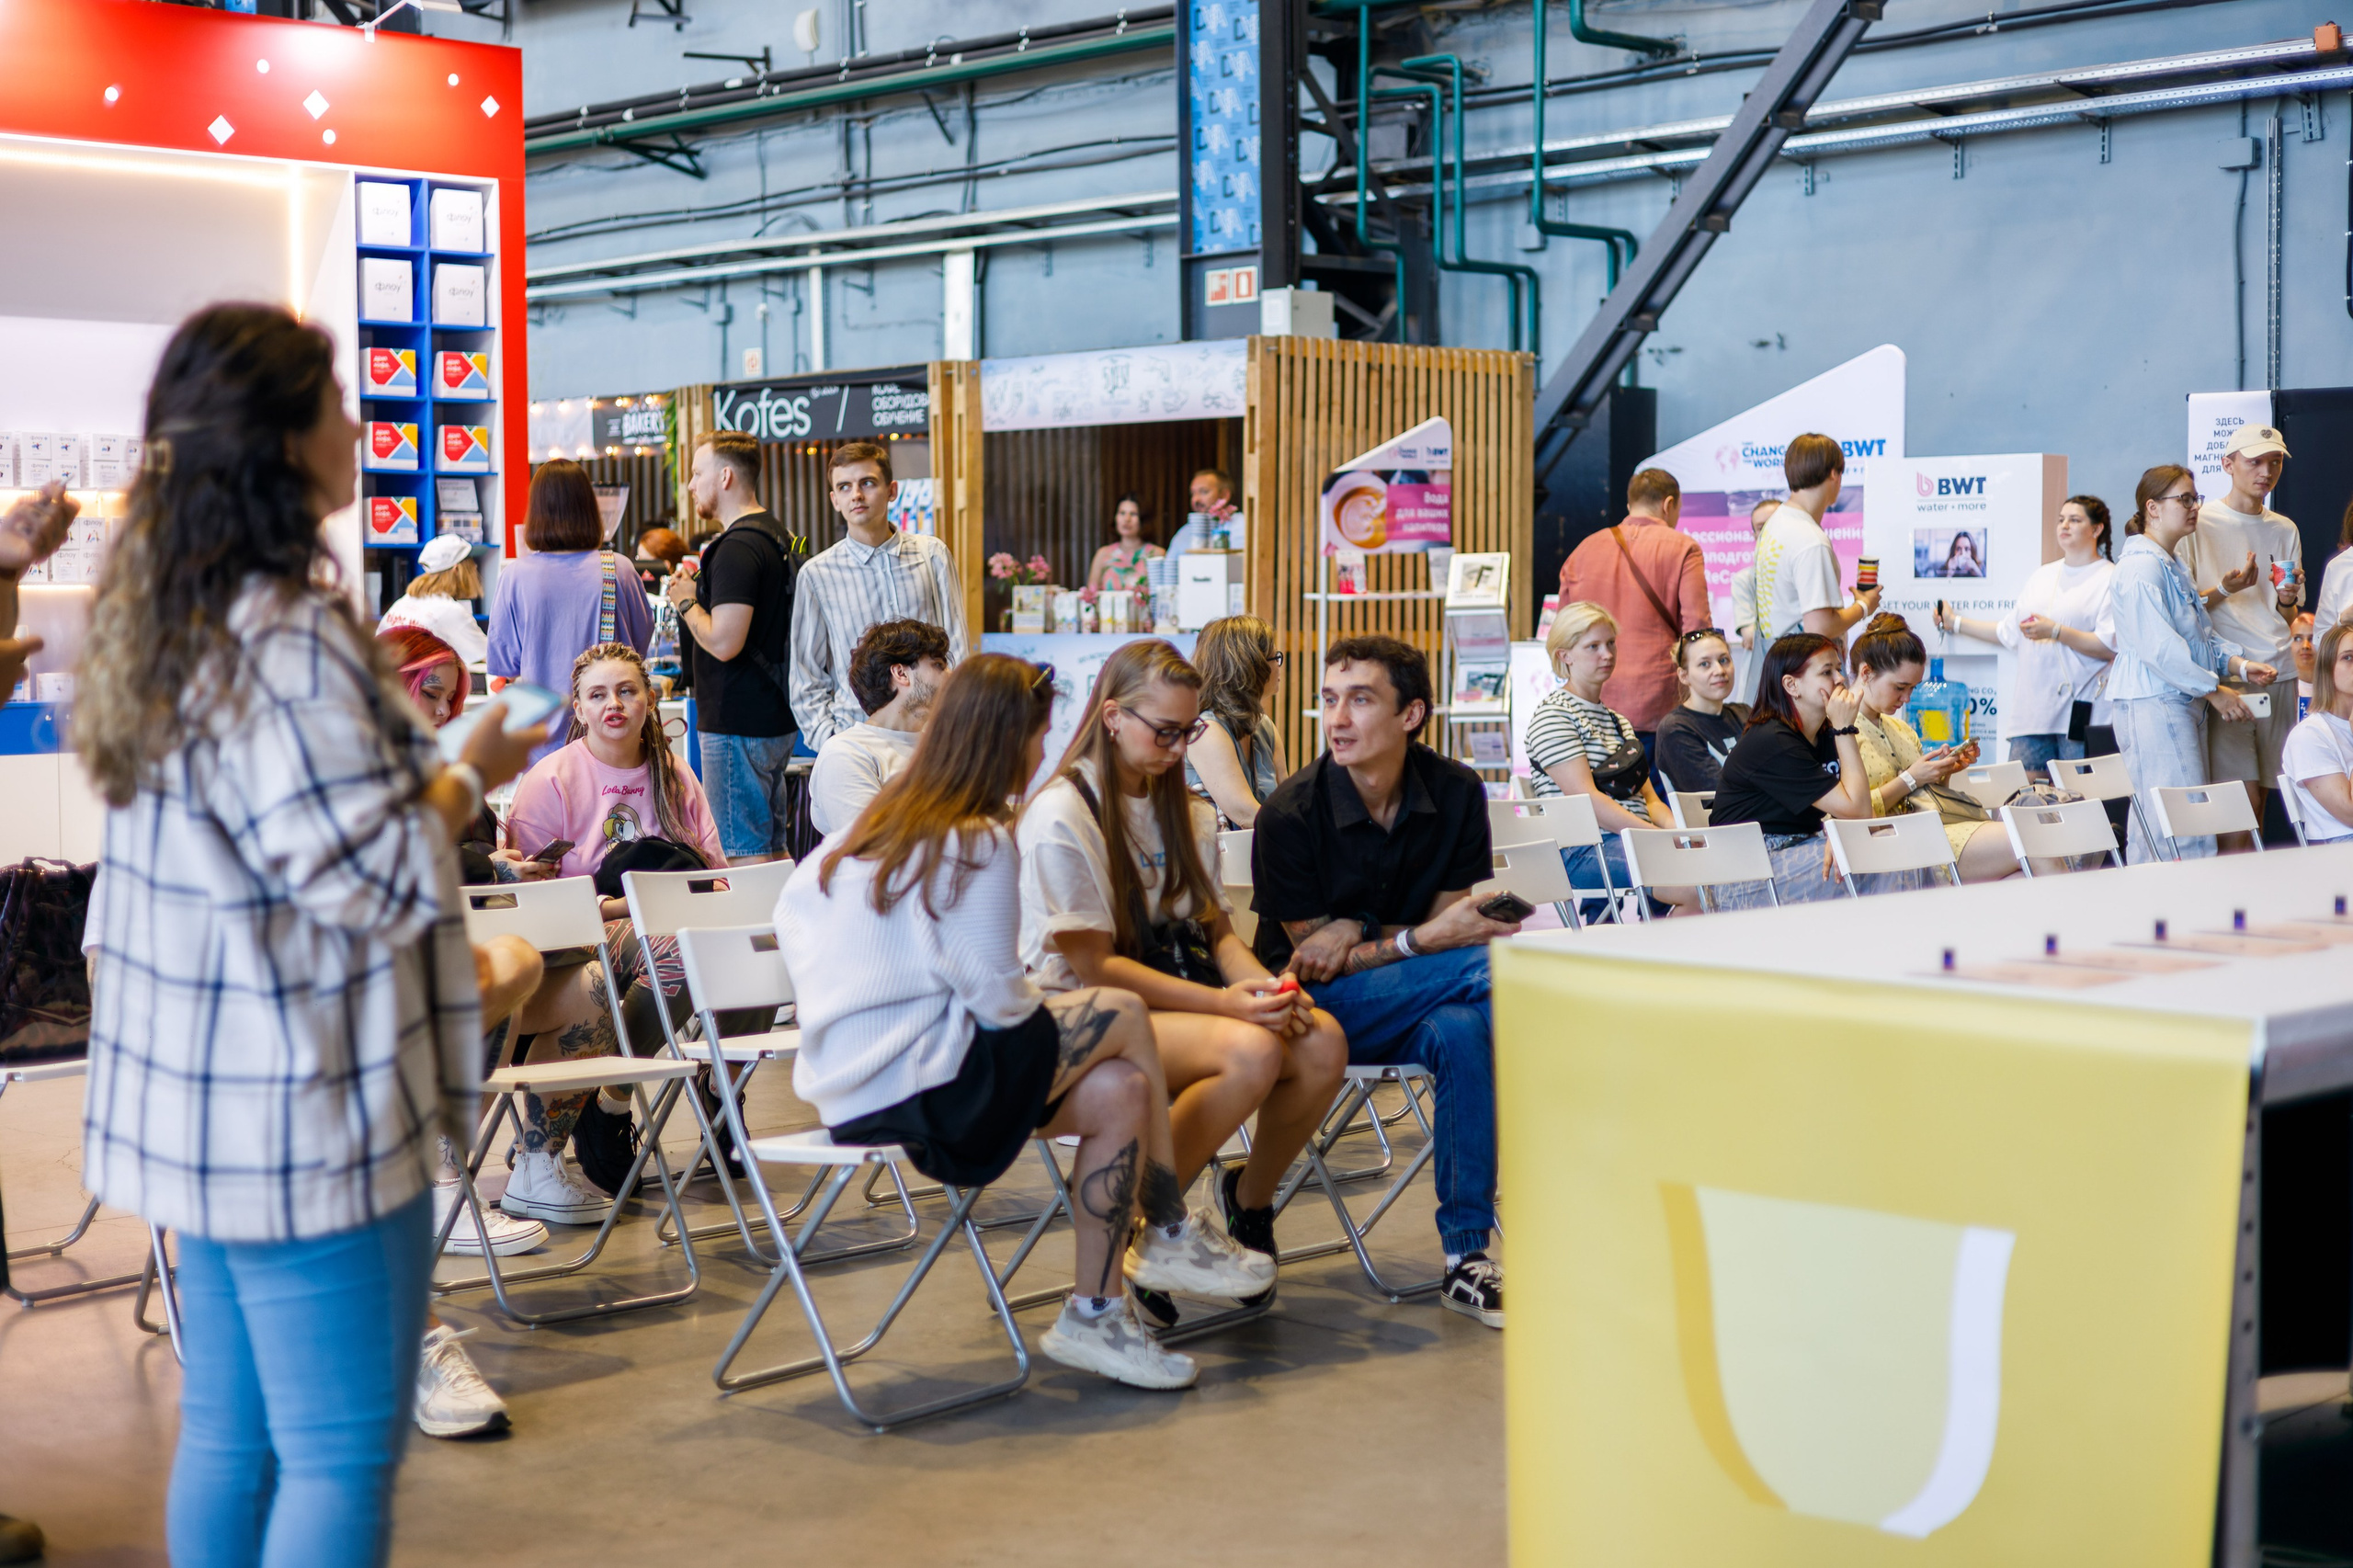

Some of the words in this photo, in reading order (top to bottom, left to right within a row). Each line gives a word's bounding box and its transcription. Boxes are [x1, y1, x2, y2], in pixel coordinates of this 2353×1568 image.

[713, 387, 812, 438] Kofes
[622, 410, 665, 437] BAKERY
[2215, 417, 2245, 426] ЗДЕСЬ
[2213, 429, 2237, 437] МОЖ
[1841, 438, 1886, 457] BWT
[2201, 464, 2222, 474] ДЛЯ
[1938, 476, 1987, 495] BWT
[1917, 503, 1948, 512] water
[1958, 502, 1986, 511] more
[1703, 551, 1755, 566] подго
[1902, 599, 1930, 610] YOUR
[1933, 599, 1972, 610] TER
[1973, 600, 1995, 610] FOR
[602, 784, 620, 796] Lola
[620, 785, 645, 797] Bunny
